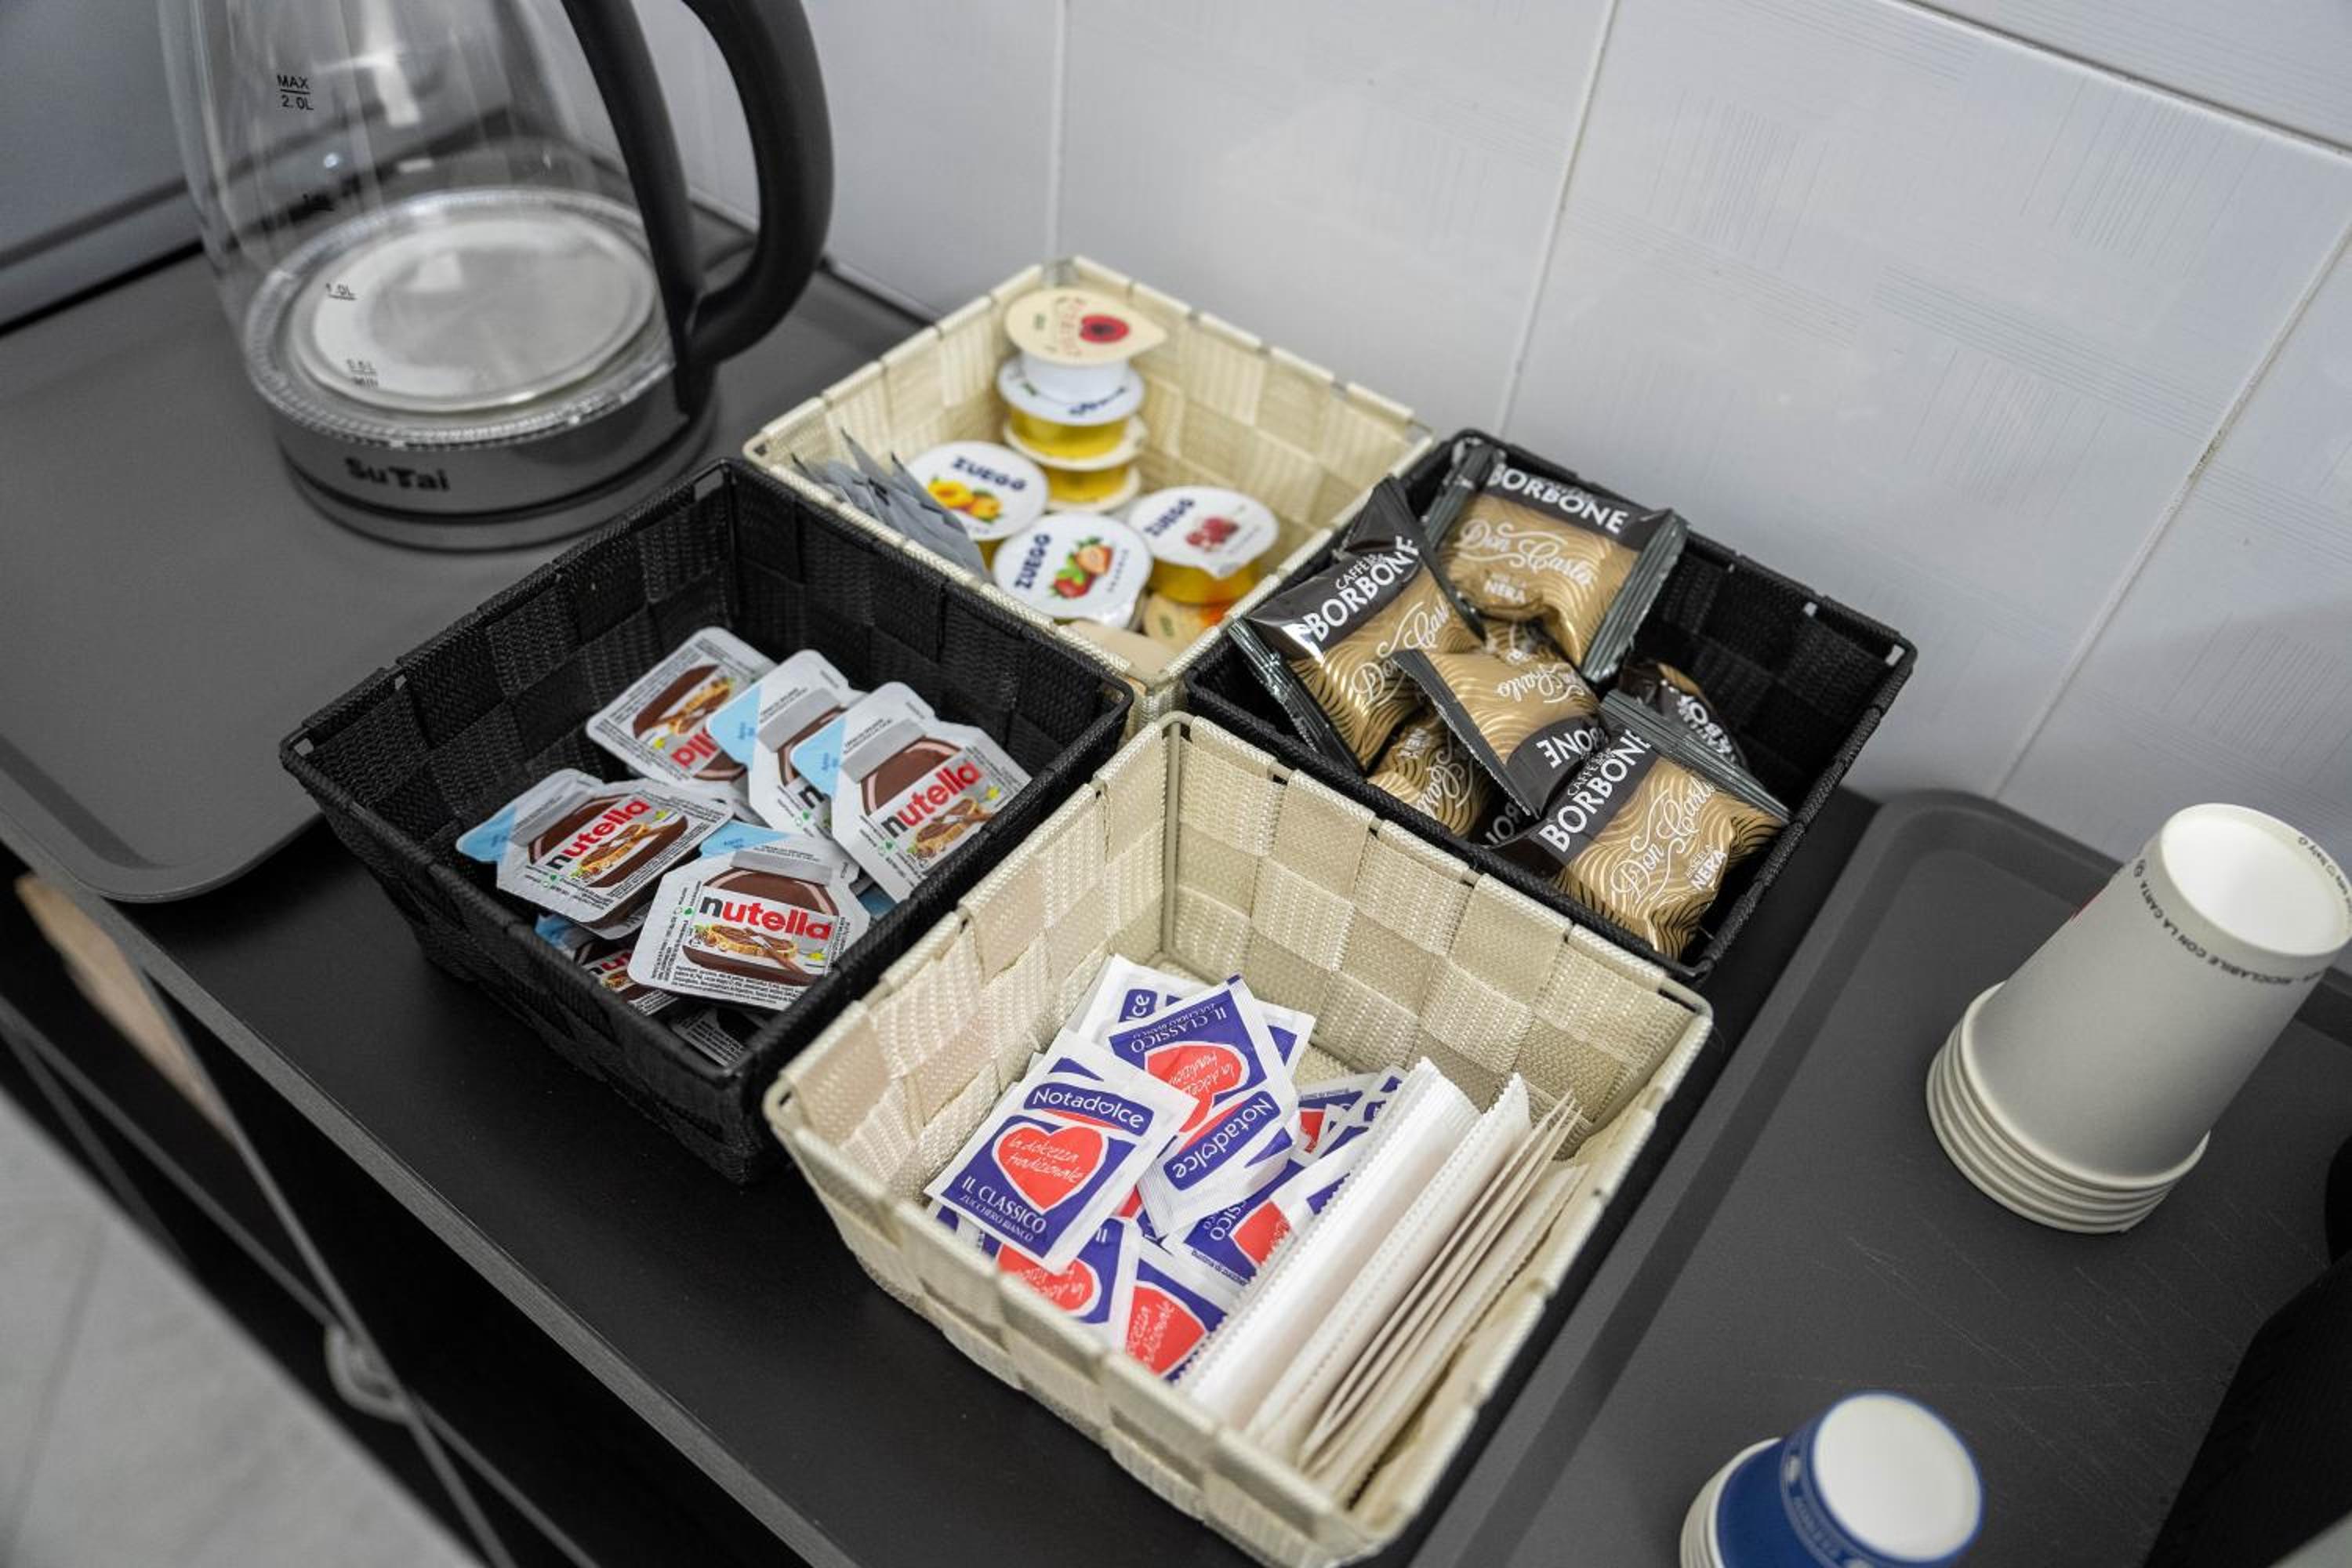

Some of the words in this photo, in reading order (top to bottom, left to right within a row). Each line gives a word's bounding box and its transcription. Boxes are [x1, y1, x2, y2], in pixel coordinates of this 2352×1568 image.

[277, 74, 310, 89] MAX
[344, 456, 451, 492] SuTai
[1486, 462, 1629, 535] BORBONE
[1301, 535, 1420, 642] BORBONE
[880, 759, 983, 839] nutella
[546, 796, 652, 873] nutella
[699, 892, 833, 942] nutella
[2140, 880, 2164, 919] CARTA
[2162, 917, 2179, 936] LA
[2178, 935, 2207, 958] CON
[1131, 1015, 1208, 1054] CLASSICO
[959, 1194, 1004, 1225] ZUCCHERO
[961, 1175, 977, 1195] IL
[978, 1185, 1047, 1234] CLASSICO
